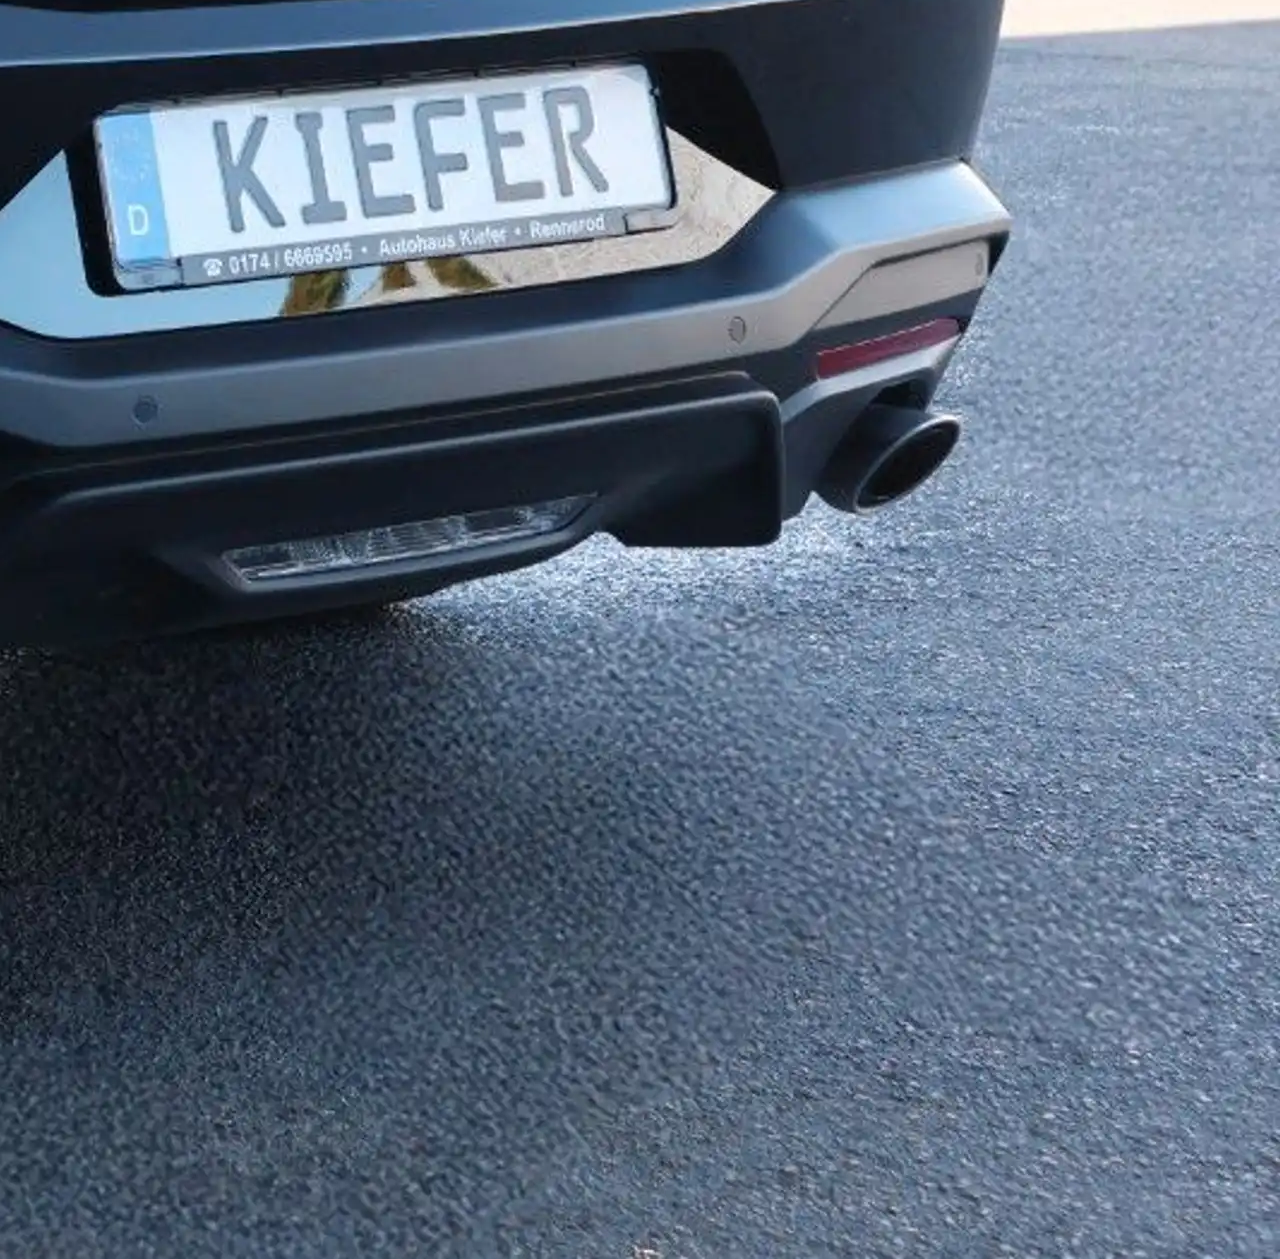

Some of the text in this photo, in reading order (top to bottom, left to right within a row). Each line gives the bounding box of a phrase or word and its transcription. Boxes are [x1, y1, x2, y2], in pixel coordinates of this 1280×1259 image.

[212, 85, 609, 233] KIEFER
[127, 203, 149, 236] D
[228, 252, 271, 275] 0174
[379, 230, 456, 257] Autohaus
[458, 224, 507, 247] Kiefer
[529, 213, 606, 239] Rennerod
